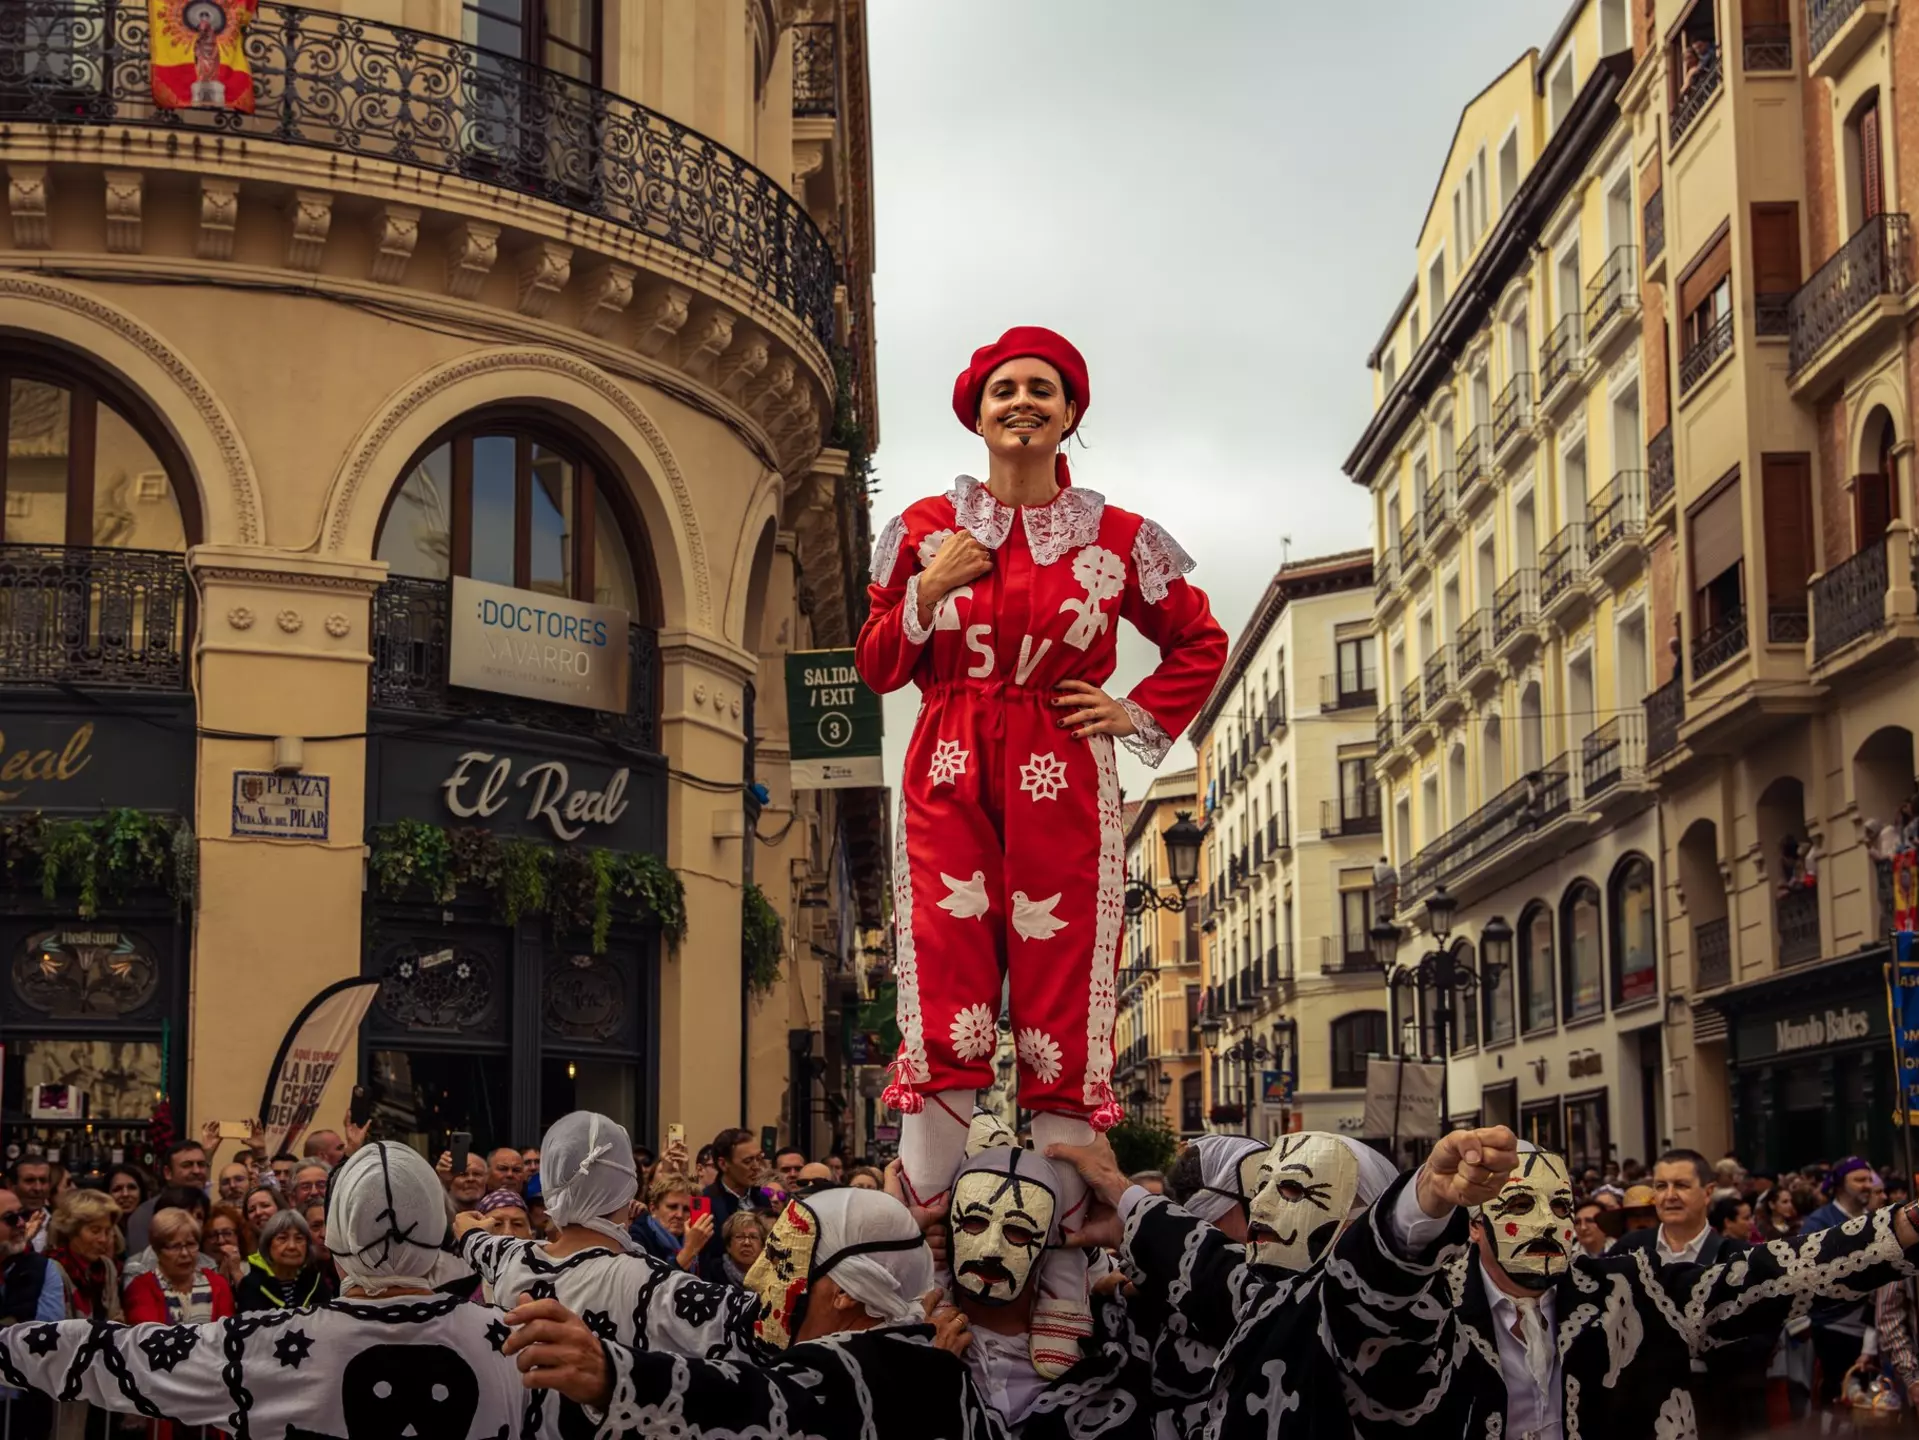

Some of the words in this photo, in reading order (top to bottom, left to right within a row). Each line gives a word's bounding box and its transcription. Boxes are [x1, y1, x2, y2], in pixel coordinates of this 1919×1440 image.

[804, 666, 859, 687] SALIDA
[820, 688, 856, 707] EXIT
[829, 722, 841, 740] 3
[0, 721, 94, 800] eal
[267, 777, 323, 798] PLAZA
[441, 751, 512, 818] El
[516, 761, 631, 841] Real
[289, 808, 326, 829] PILAR
[1825, 1007, 1869, 1044] Bakes
[281, 1061, 300, 1084] LA
